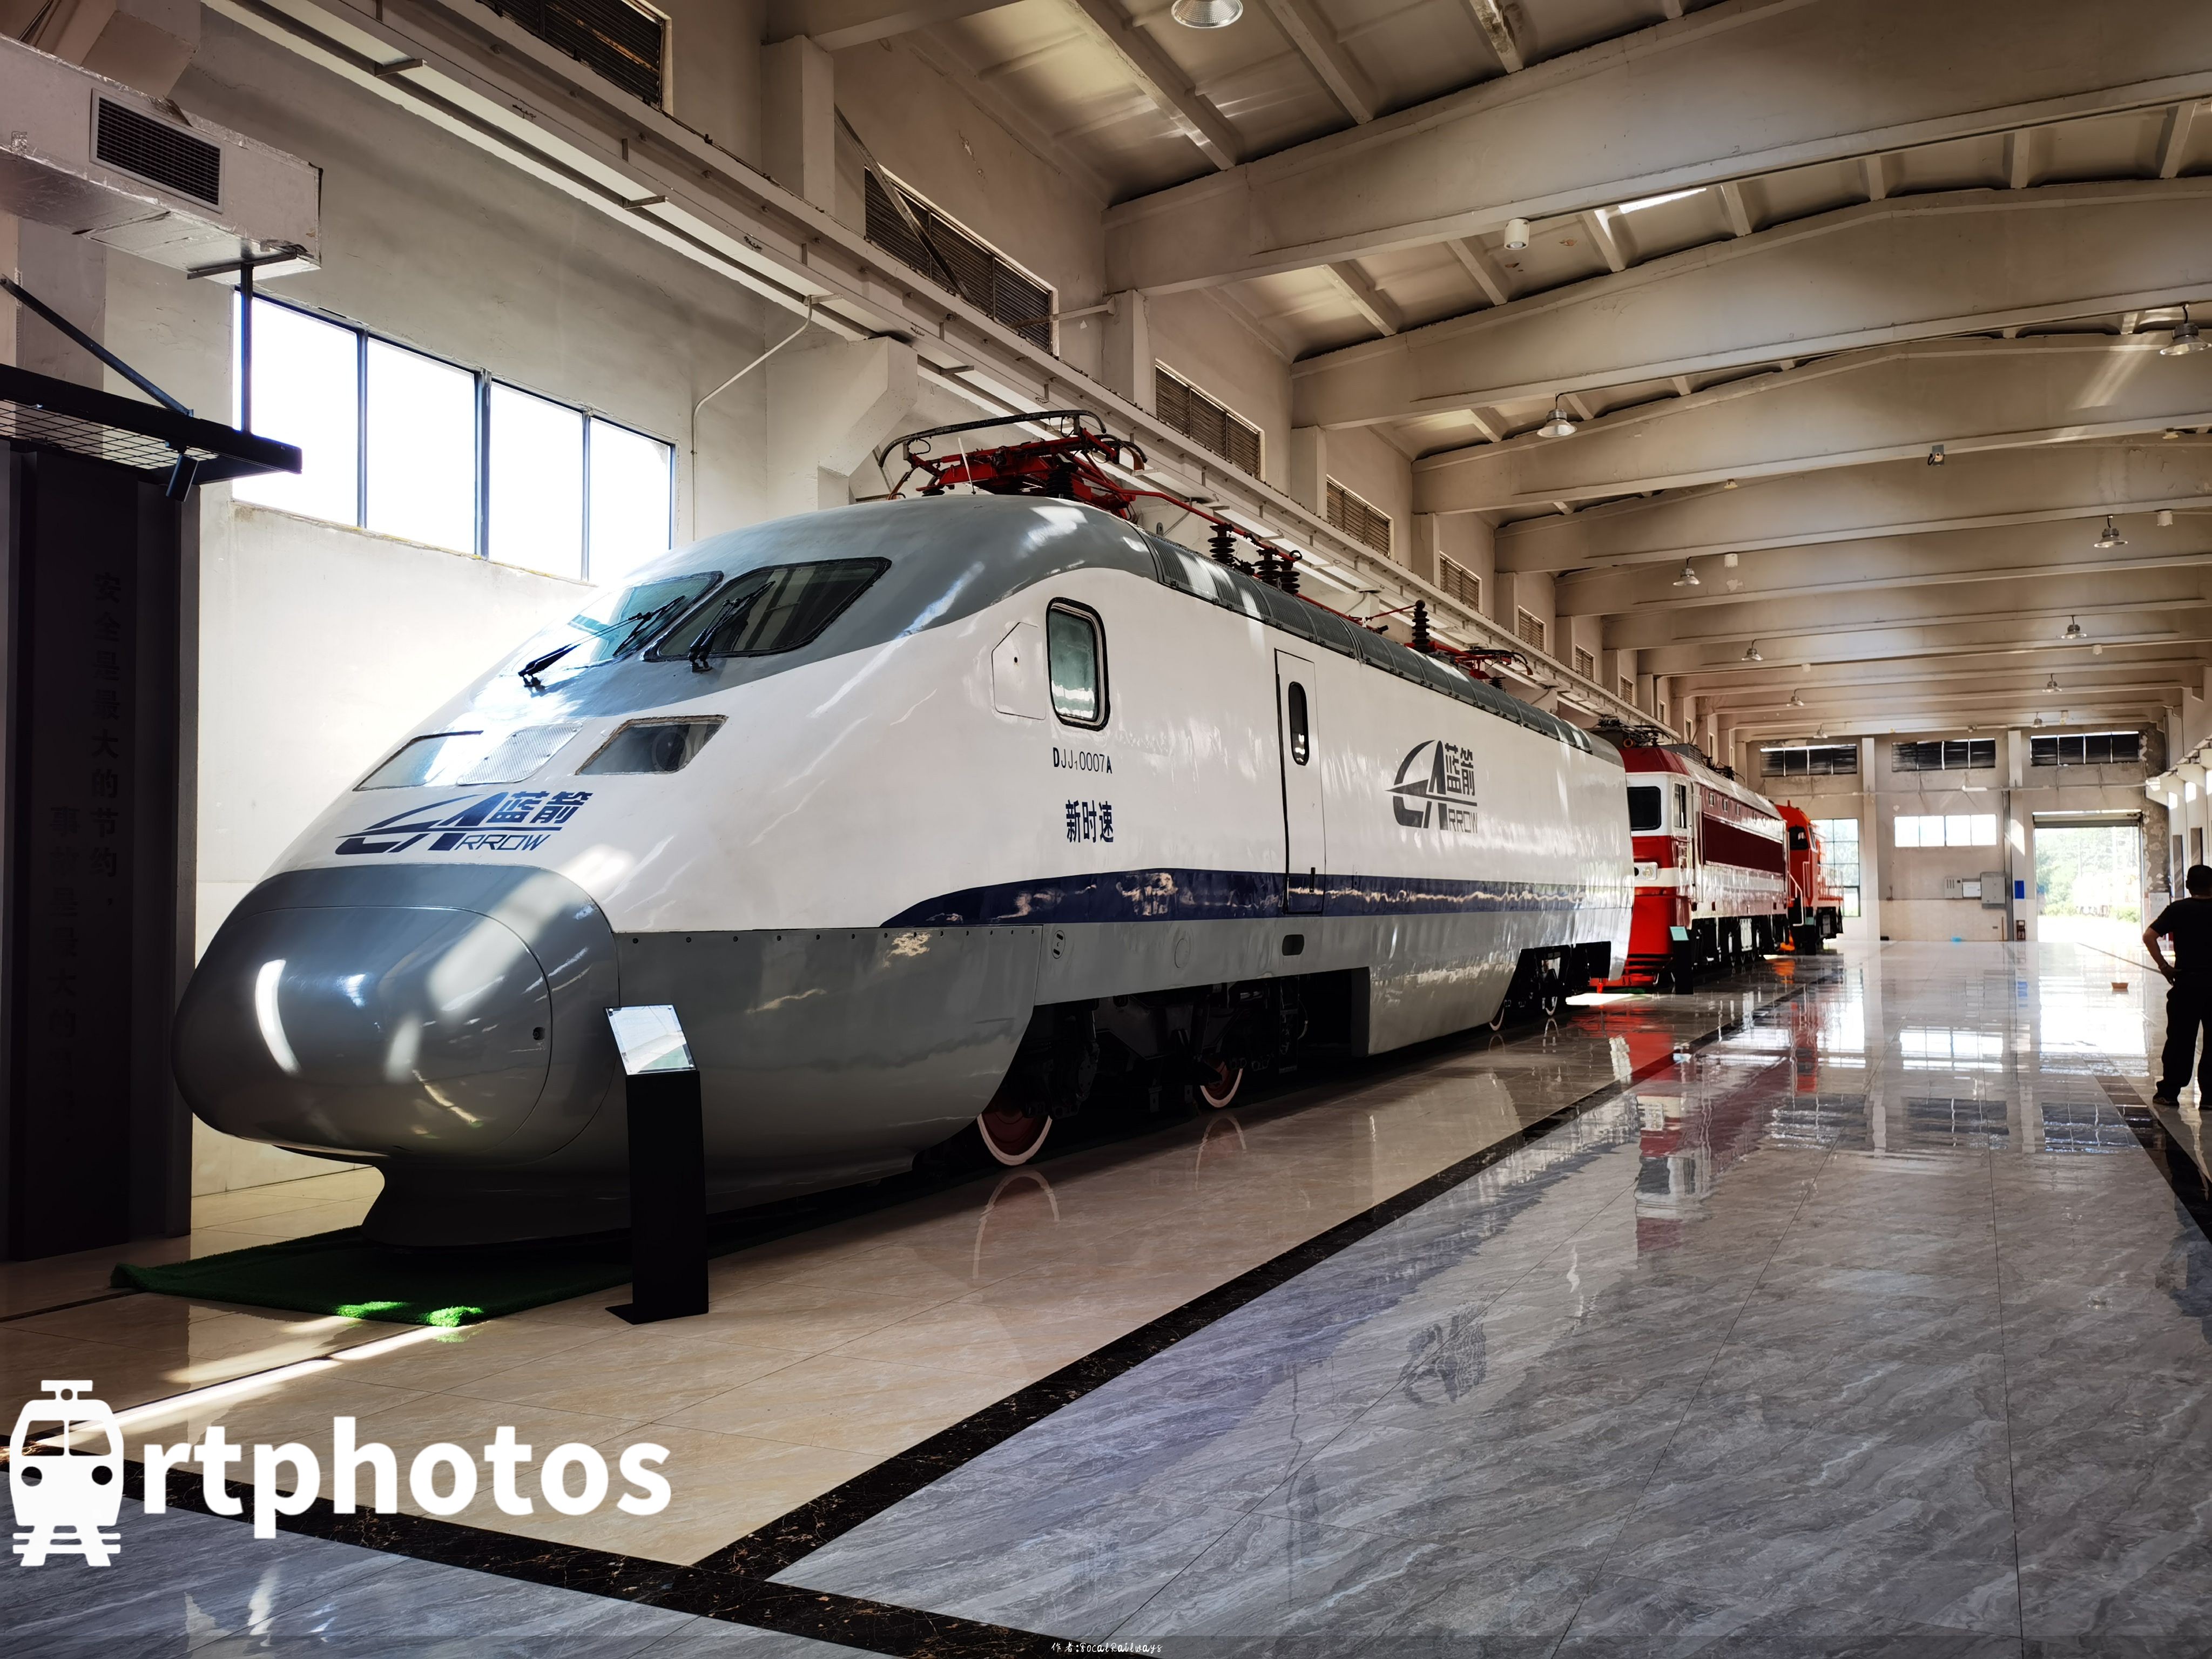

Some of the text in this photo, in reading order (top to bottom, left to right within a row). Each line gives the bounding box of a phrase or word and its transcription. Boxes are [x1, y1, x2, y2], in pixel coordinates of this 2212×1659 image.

[1445, 743, 1475, 796] 蓝箭
[485, 791, 594, 824] 蓝箭
[1065, 799, 1114, 844] 新时速
